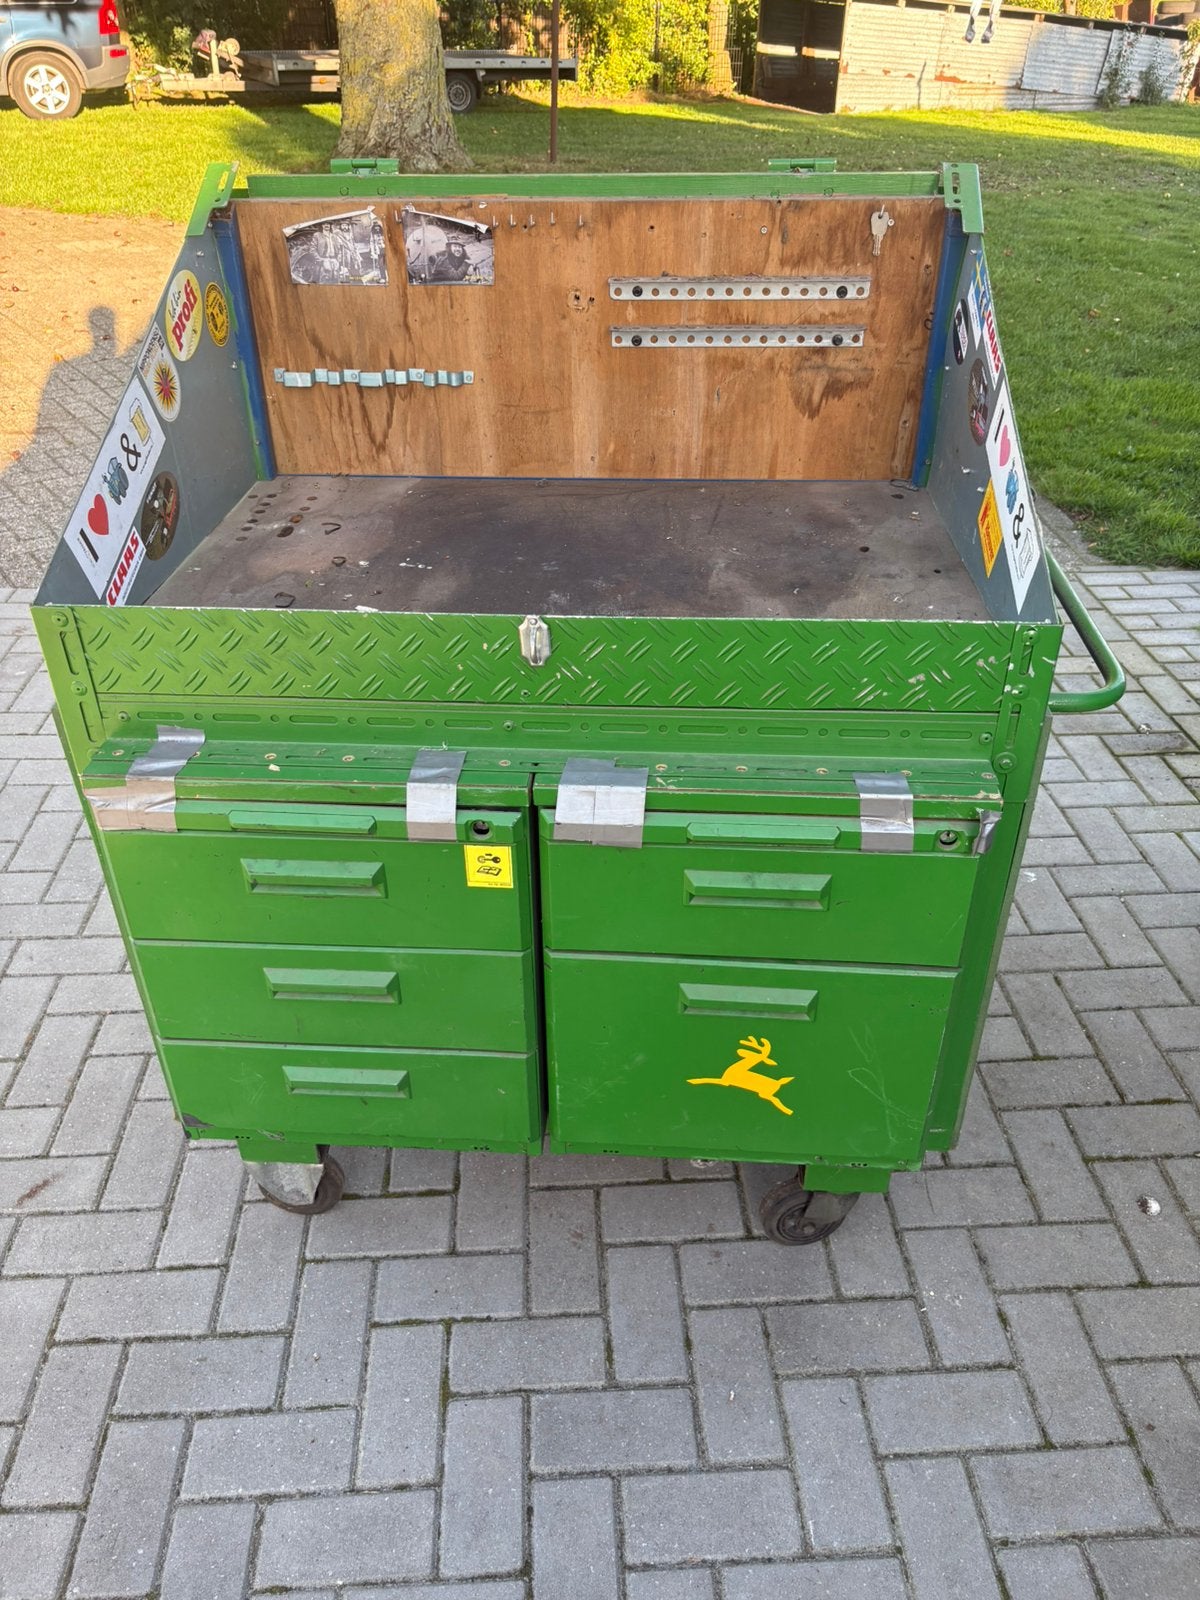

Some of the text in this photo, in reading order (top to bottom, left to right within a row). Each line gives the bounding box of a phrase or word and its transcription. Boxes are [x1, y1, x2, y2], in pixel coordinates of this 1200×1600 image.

[172, 278, 198, 352] profi
[986, 309, 1002, 374] CLAAS
[79, 528, 99, 563] I
[119, 433, 142, 472] &
[1012, 503, 1025, 548] &
[107, 532, 139, 606] CLAAS
